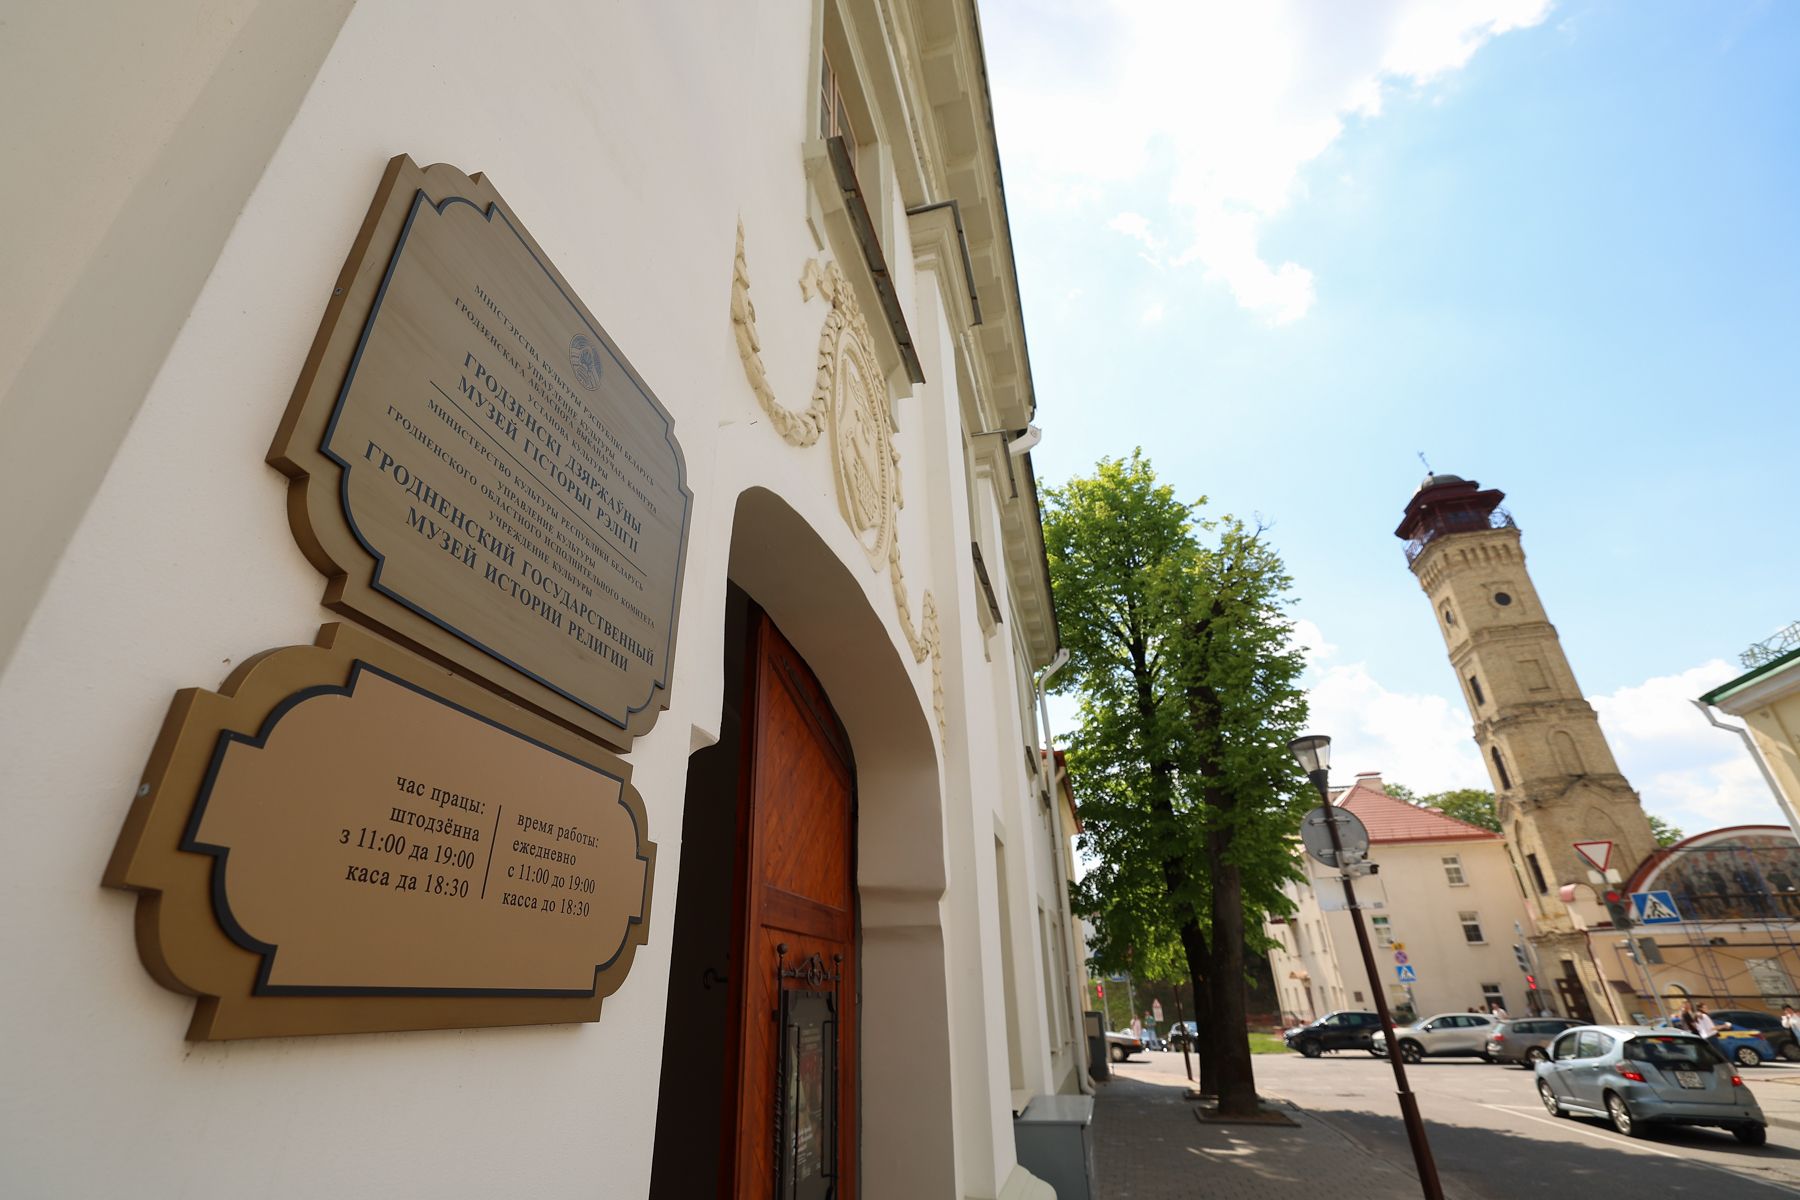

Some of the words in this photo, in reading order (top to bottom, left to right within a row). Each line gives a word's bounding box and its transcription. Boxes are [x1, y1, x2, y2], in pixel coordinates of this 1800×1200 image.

[454, 297, 526, 378] ГРОДЗЕНСКАГА
[474, 284, 540, 361] МІНІСТЭРСТВА
[542, 360, 582, 407] КУЛЬТУРЫ
[583, 406, 623, 453] РЭСПУБЛІКІ
[458, 375, 519, 442] МУЗЕЙ
[523, 438, 592, 511] ГІСТОРЫІ
[597, 506, 639, 554] РЭЛІГІІ
[464, 351, 562, 458] ГРОДЗЕНСКІ
[565, 455, 641, 536] ДЗЯРЖАЎНЫ
[527, 393, 570, 441] УСТАНОВА
[572, 440, 608, 480] КУЛЬТУРЫ
[580, 419, 616, 461] КУЛЬТУРЫ
[387, 405, 477, 486] ГРОДНЕНСКОГО
[481, 484, 542, 539] ОБЛАСТНОГО
[544, 536, 619, 601] ИСПОЛНИТЕЛЬНОГО
[621, 597, 656, 629] КОМИТЕТА
[427, 399, 511, 478] МИНИСТЕРСТВО
[514, 475, 559, 520] КУЛЬТУРЫ
[561, 516, 609, 563] РЕСПУБЛИКИ
[611, 559, 643, 592] БЕЛАРУСЬ
[498, 480, 554, 535] УПРАВЛЕНИЕ
[556, 530, 596, 569] КУЛЬТУРЫ
[363, 440, 516, 567] ГРОДНЕНСКИЙ
[521, 560, 655, 667] ГОСУДАРСТВЕННЫЙ
[405, 506, 477, 569] МУЗЕЙ
[484, 561, 562, 628] ИСТОРИИ
[567, 620, 629, 672] РЕЛИГИИ
[488, 510, 550, 565] УЧРЕЖДЕНИЕ
[552, 561, 593, 598] КУЛЬТУРЫ
[389, 806, 480, 842] штодзённа
[397, 776, 425, 797] час
[430, 786, 486, 815] працы:
[517, 814, 554, 834] время
[556, 825, 600, 849] работы:
[344, 864, 390, 887] каса
[395, 873, 418, 891] да
[424, 873, 470, 899] 18:30
[357, 827, 406, 856] 11:00
[408, 844, 430, 861] да
[434, 844, 476, 870] 19:00
[507, 864, 515, 878] с
[518, 863, 550, 886] 11:00
[551, 875, 566, 889] до
[568, 876, 596, 895] 19:00
[512, 838, 577, 866] ежедневно
[502, 890, 538, 910] касса
[541, 900, 556, 913] до
[560, 898, 590, 918] 18:30
